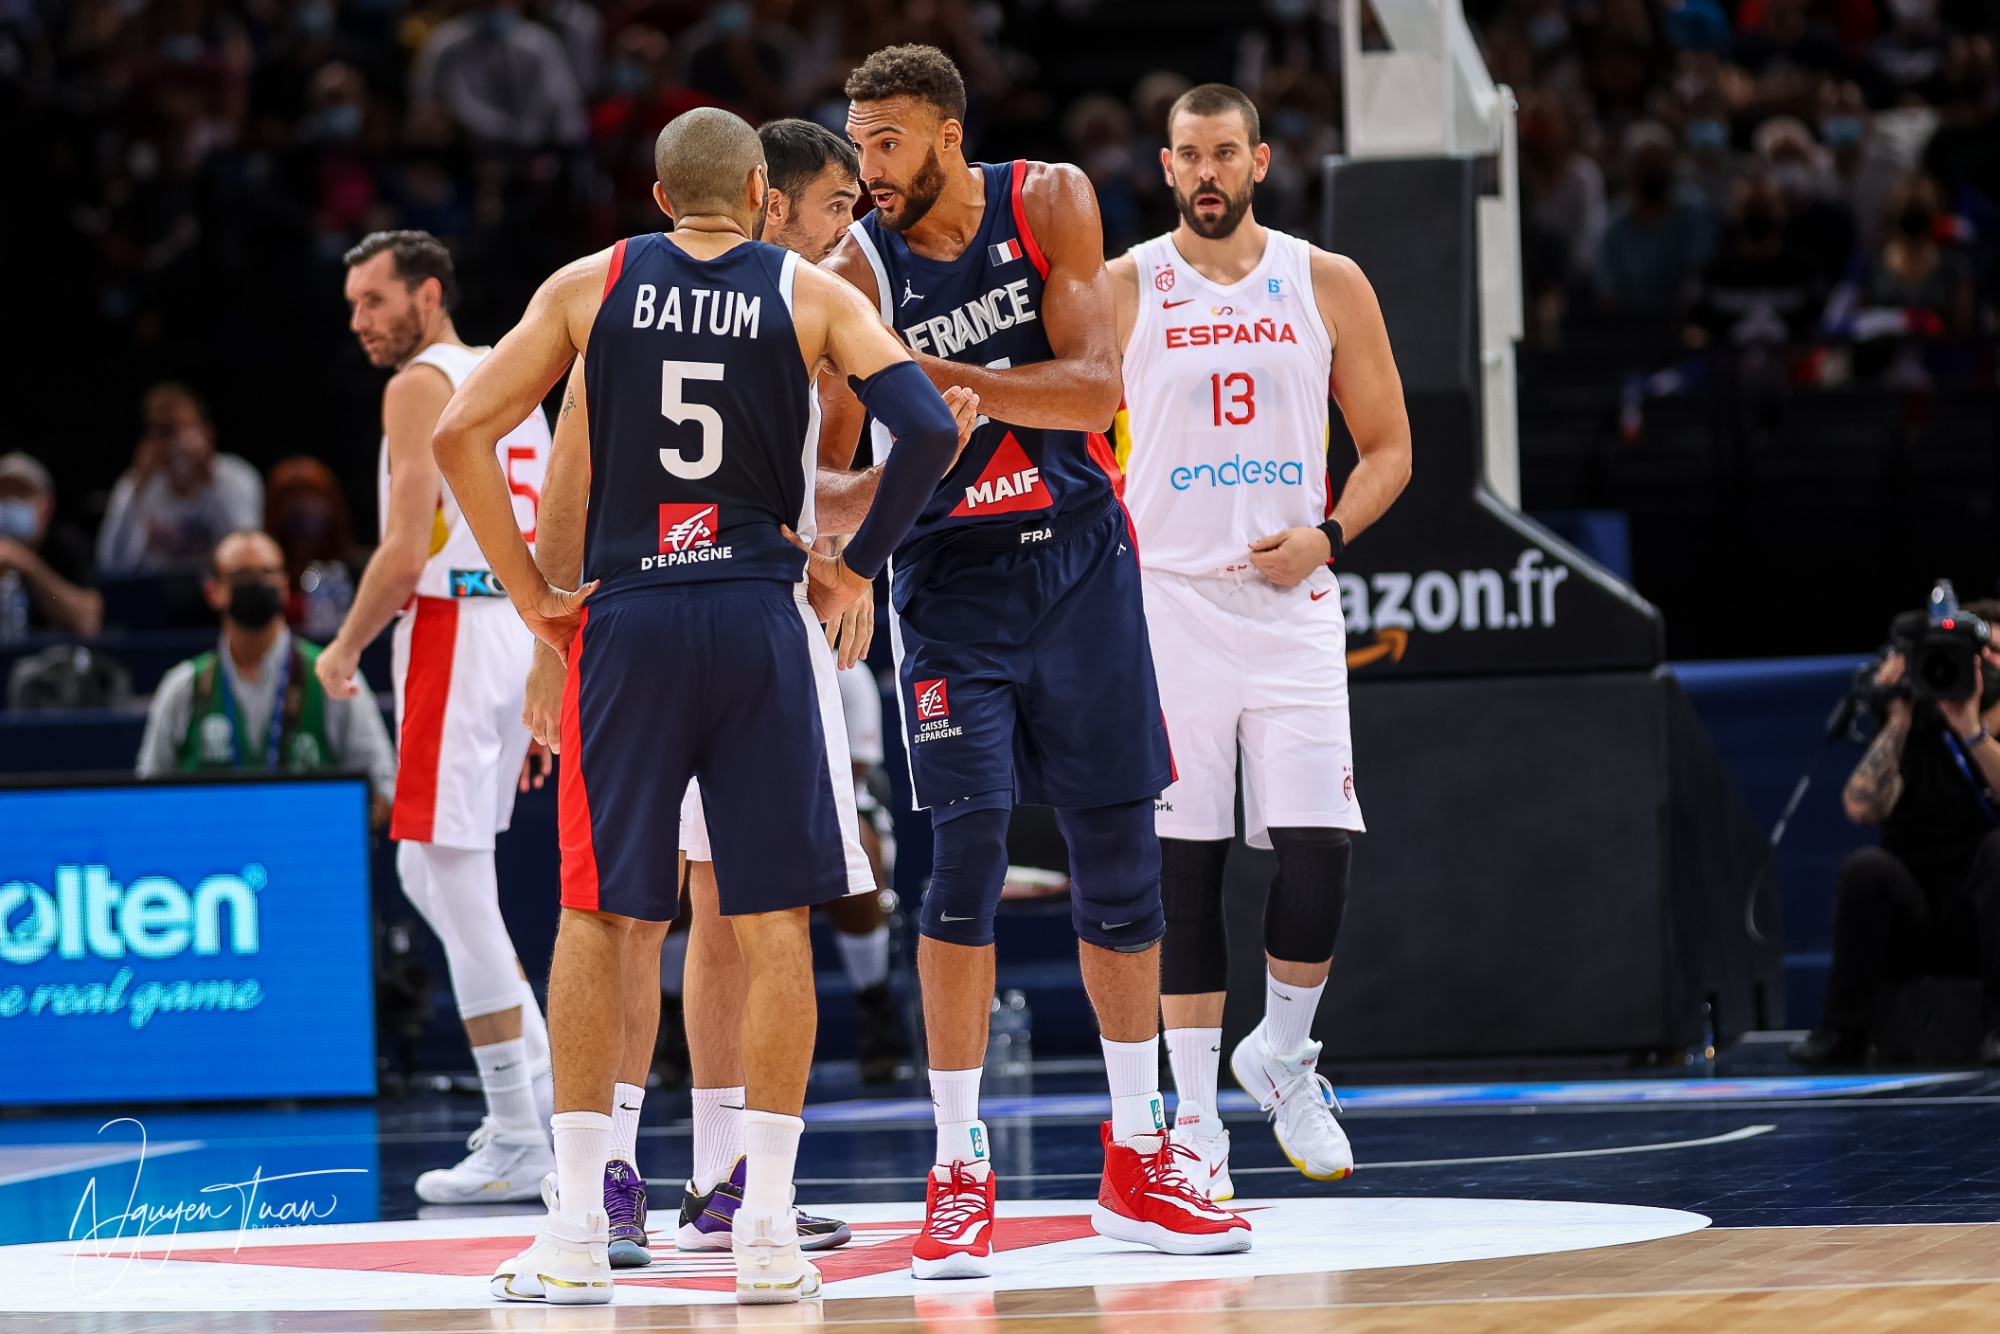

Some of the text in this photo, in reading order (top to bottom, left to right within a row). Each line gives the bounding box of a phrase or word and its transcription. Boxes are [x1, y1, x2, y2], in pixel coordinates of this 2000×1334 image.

[632, 283, 761, 339] BATUM
[902, 277, 1038, 359] FRANCE
[1166, 317, 1298, 349] ESPAÑA
[659, 360, 725, 480] 5
[1211, 372, 1256, 427] 13
[965, 467, 1040, 509] MAIF
[1170, 453, 1303, 491] endesa
[1020, 527, 1053, 544] FRA
[920, 718, 950, 732] CAISSE
